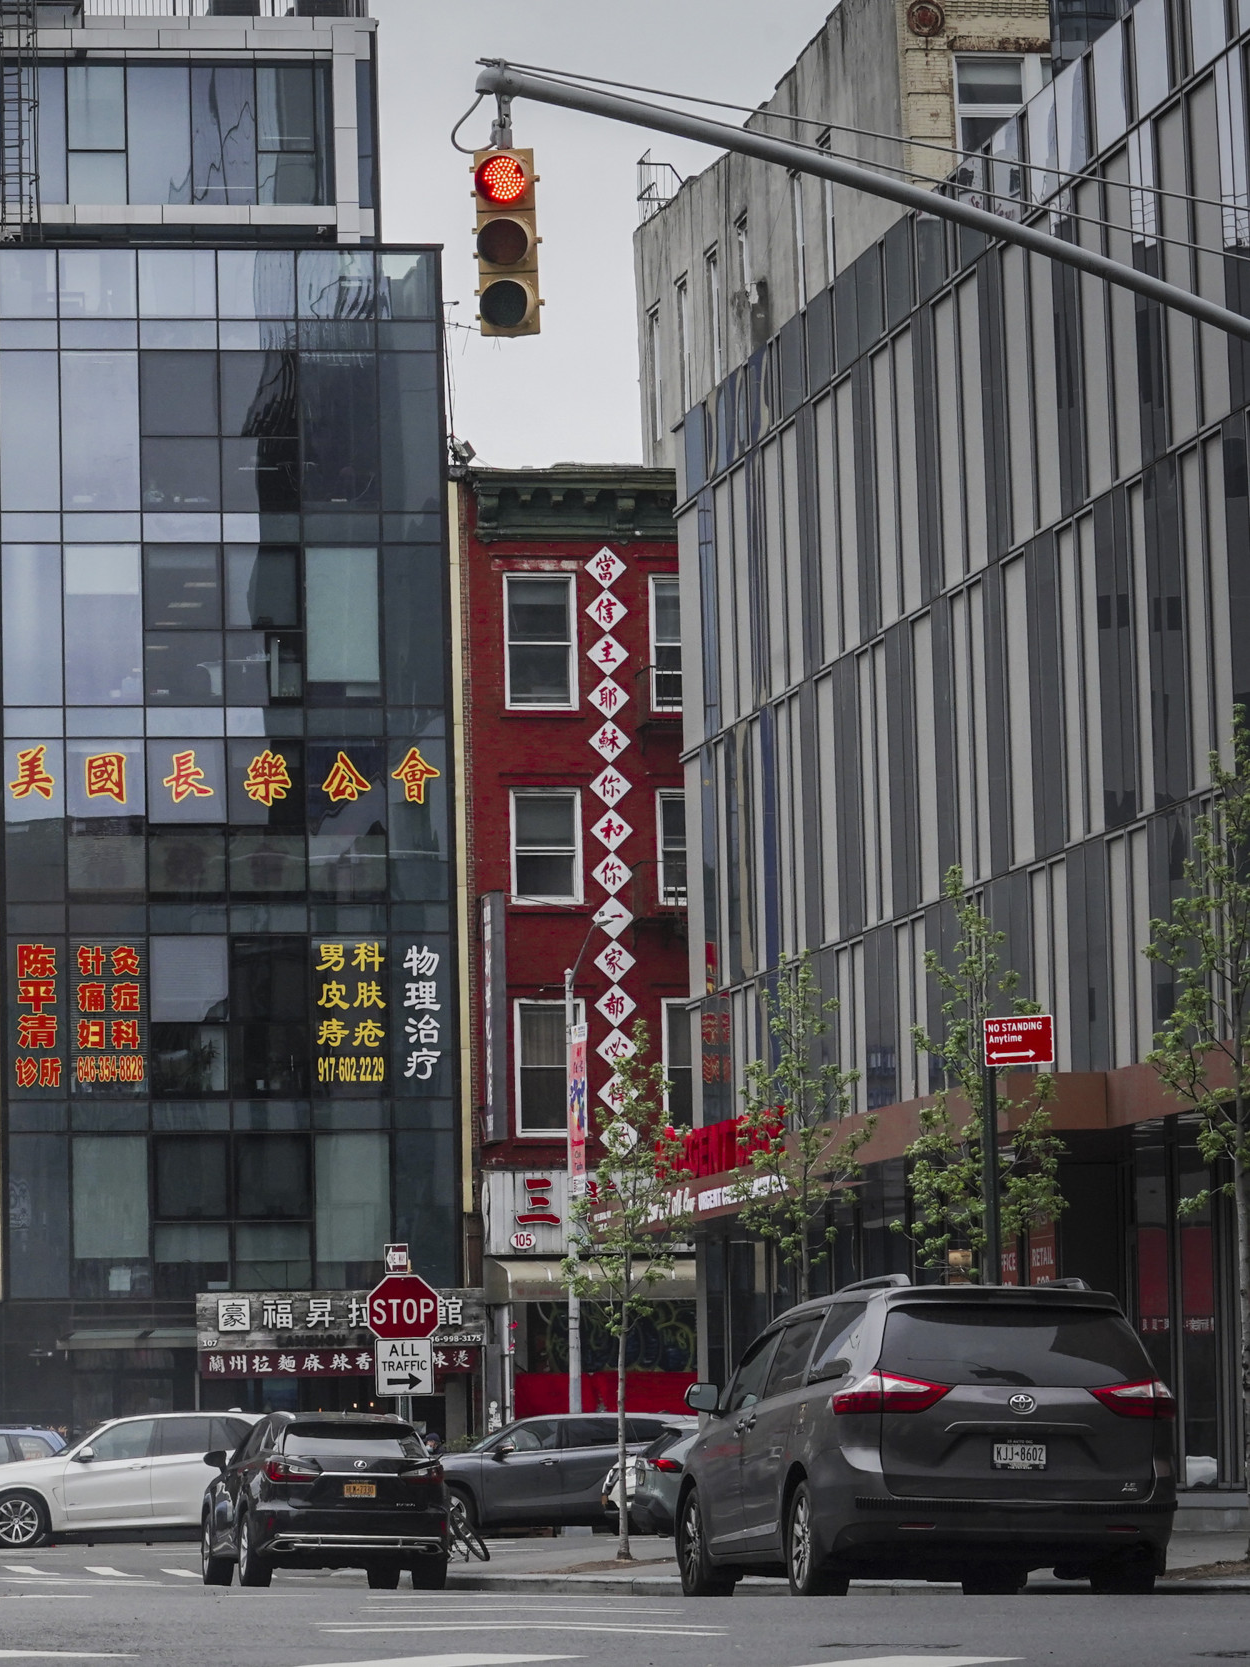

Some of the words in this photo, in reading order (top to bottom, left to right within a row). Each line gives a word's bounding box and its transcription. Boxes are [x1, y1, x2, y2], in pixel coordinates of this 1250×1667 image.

[9, 745, 440, 806] 美國長樂公會
[77, 946, 140, 976] 针灸
[315, 942, 385, 972] 男科
[77, 982, 140, 1012] 痛症
[317, 980, 387, 1010] 皮肤
[403, 945, 441, 1080] 物理治疗
[77, 1019, 140, 1049] 妇科
[316, 1018, 385, 1047] 痔疮
[988, 1023, 999, 1033] NO
[1002, 1021, 1043, 1032] STANDING
[989, 1034, 1022, 1045] Anytime
[77, 1055, 144, 1082] 646-354-8828
[317, 1056, 384, 1082] 917-602-2229
[514, 1233, 532, 1247] 105
[1031, 1246, 1054, 1267] RETAIL
[372, 1298, 435, 1325] STOP
[203, 1339, 218, 1347] 107
[389, 1343, 420, 1357] ALL
[381, 1360, 428, 1372] TRAFFIC
